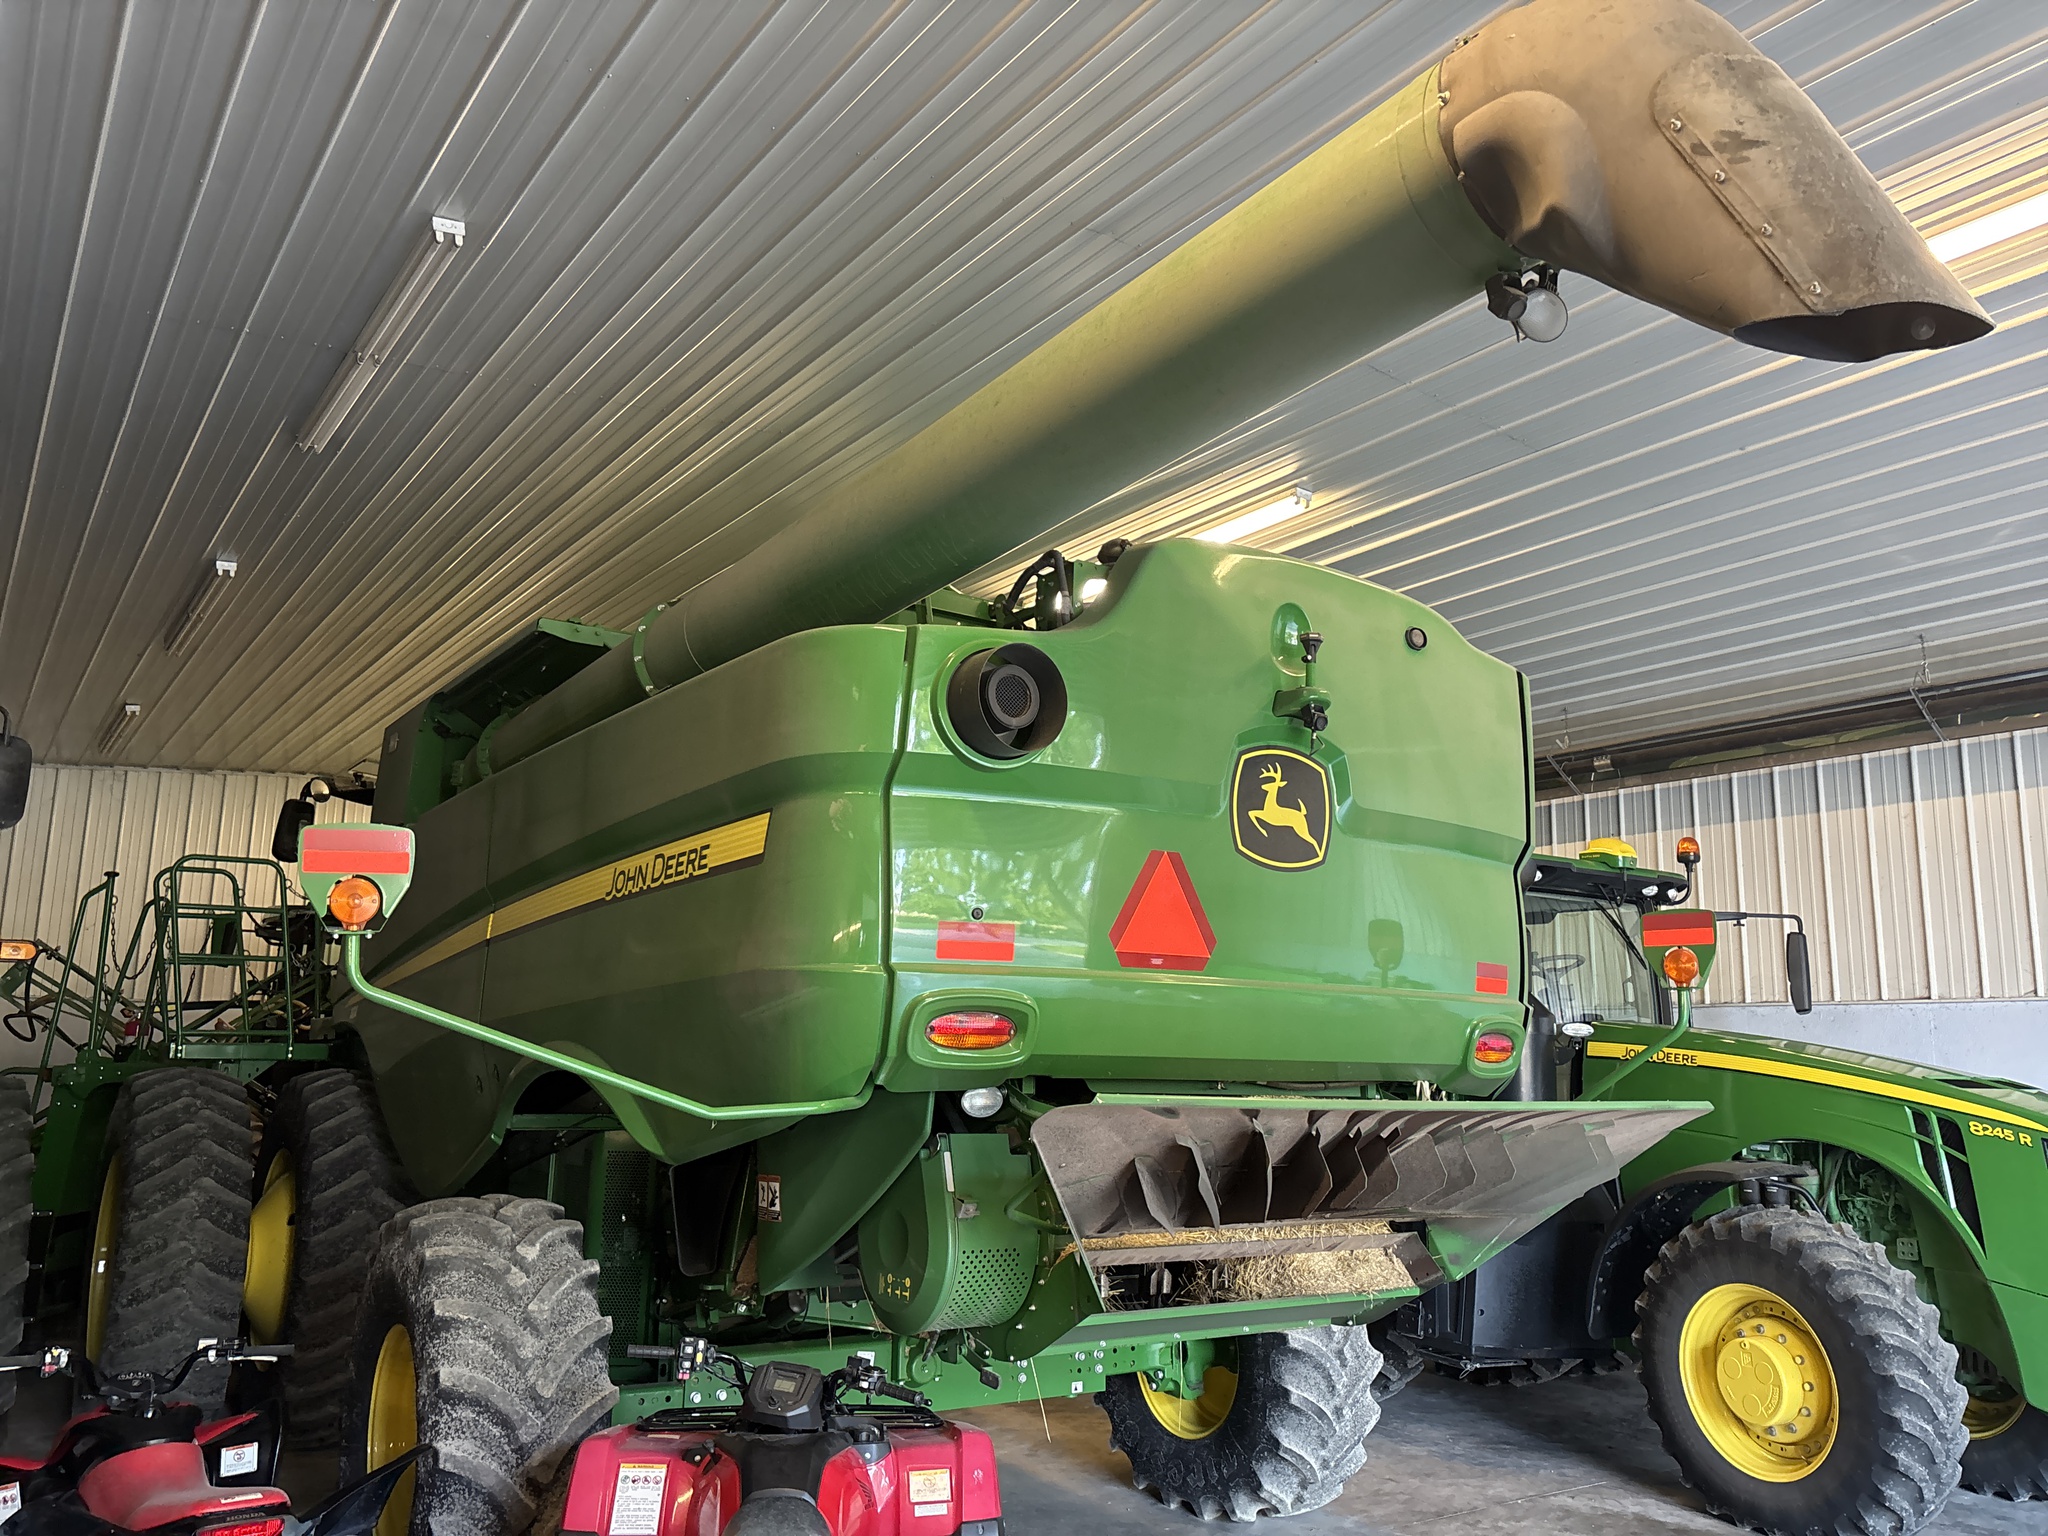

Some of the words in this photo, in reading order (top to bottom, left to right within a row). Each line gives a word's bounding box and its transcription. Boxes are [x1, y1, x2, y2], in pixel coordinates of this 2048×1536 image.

[604, 863, 649, 898] JOHN
[651, 843, 711, 884] DEERE
[1621, 1046, 1655, 1061] JO
[1656, 1049, 1698, 1065] DEERE
[1968, 1120, 2015, 1142] 8245
[2018, 1132, 2033, 1148] R
[226, 1511, 266, 1521] HONDA
